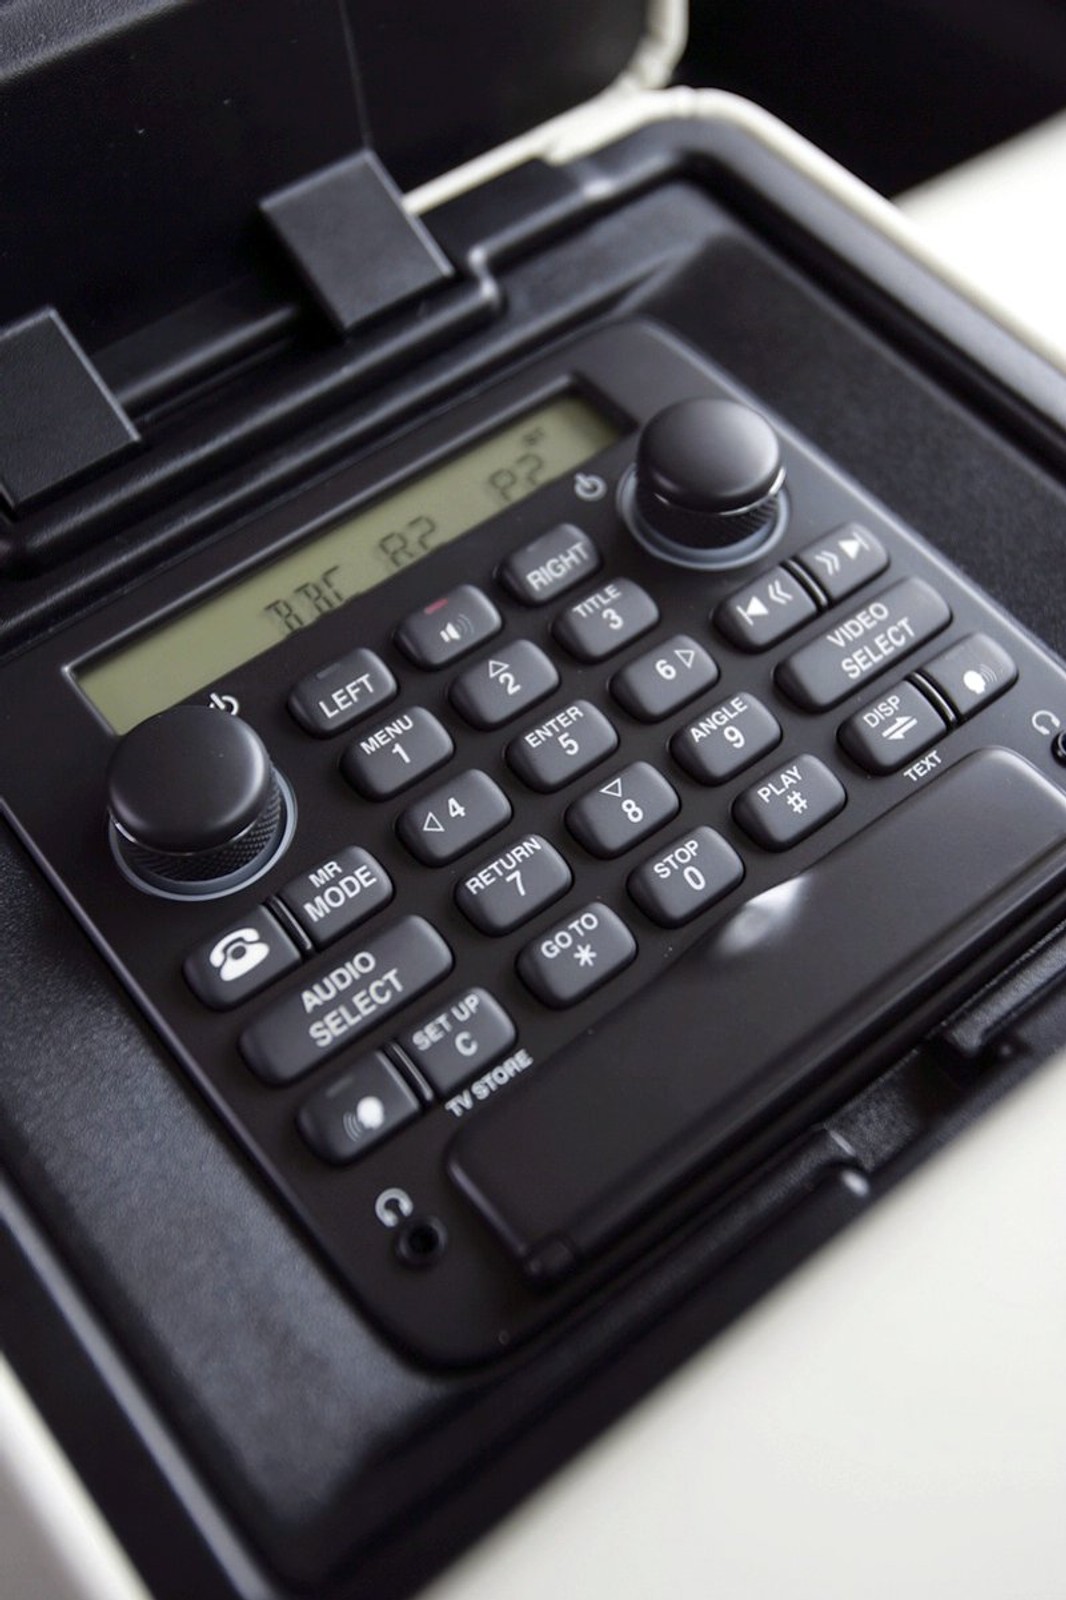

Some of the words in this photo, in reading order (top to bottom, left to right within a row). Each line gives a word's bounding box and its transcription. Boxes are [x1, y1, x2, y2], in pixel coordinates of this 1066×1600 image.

[526, 542, 589, 592] RIGHT
[572, 584, 622, 619] TITLE
[602, 608, 624, 631] 3
[826, 602, 890, 649] VIDEO
[841, 617, 918, 679] SELECT
[498, 673, 521, 695] 2
[655, 659, 676, 681] 6
[318, 674, 375, 719] LEFT
[863, 695, 902, 729] DISP
[360, 715, 414, 755] MENU
[524, 706, 584, 749] ENTER
[689, 697, 749, 744] ANGLE
[723, 725, 746, 750] 9
[391, 743, 411, 765] 1
[557, 732, 579, 756] 5
[758, 765, 804, 804] PLAY
[903, 751, 943, 783] TEXT
[447, 797, 466, 819] 4
[621, 799, 644, 823] 8
[308, 860, 343, 888] MR
[465, 837, 542, 896] RETURN
[653, 839, 700, 880] STOP
[683, 865, 707, 891] 0
[303, 864, 378, 923] MODE
[506, 870, 526, 897] 7
[540, 931, 572, 960] GO
[569, 912, 599, 938] TO
[300, 951, 376, 1014] AUDIO
[308, 968, 404, 1048] SELECT
[411, 1015, 453, 1052] SET
[452, 993, 481, 1023] UP
[454, 1031, 478, 1056] C
[445, 1092, 473, 1117] TV
[471, 1048, 534, 1101] STORE
